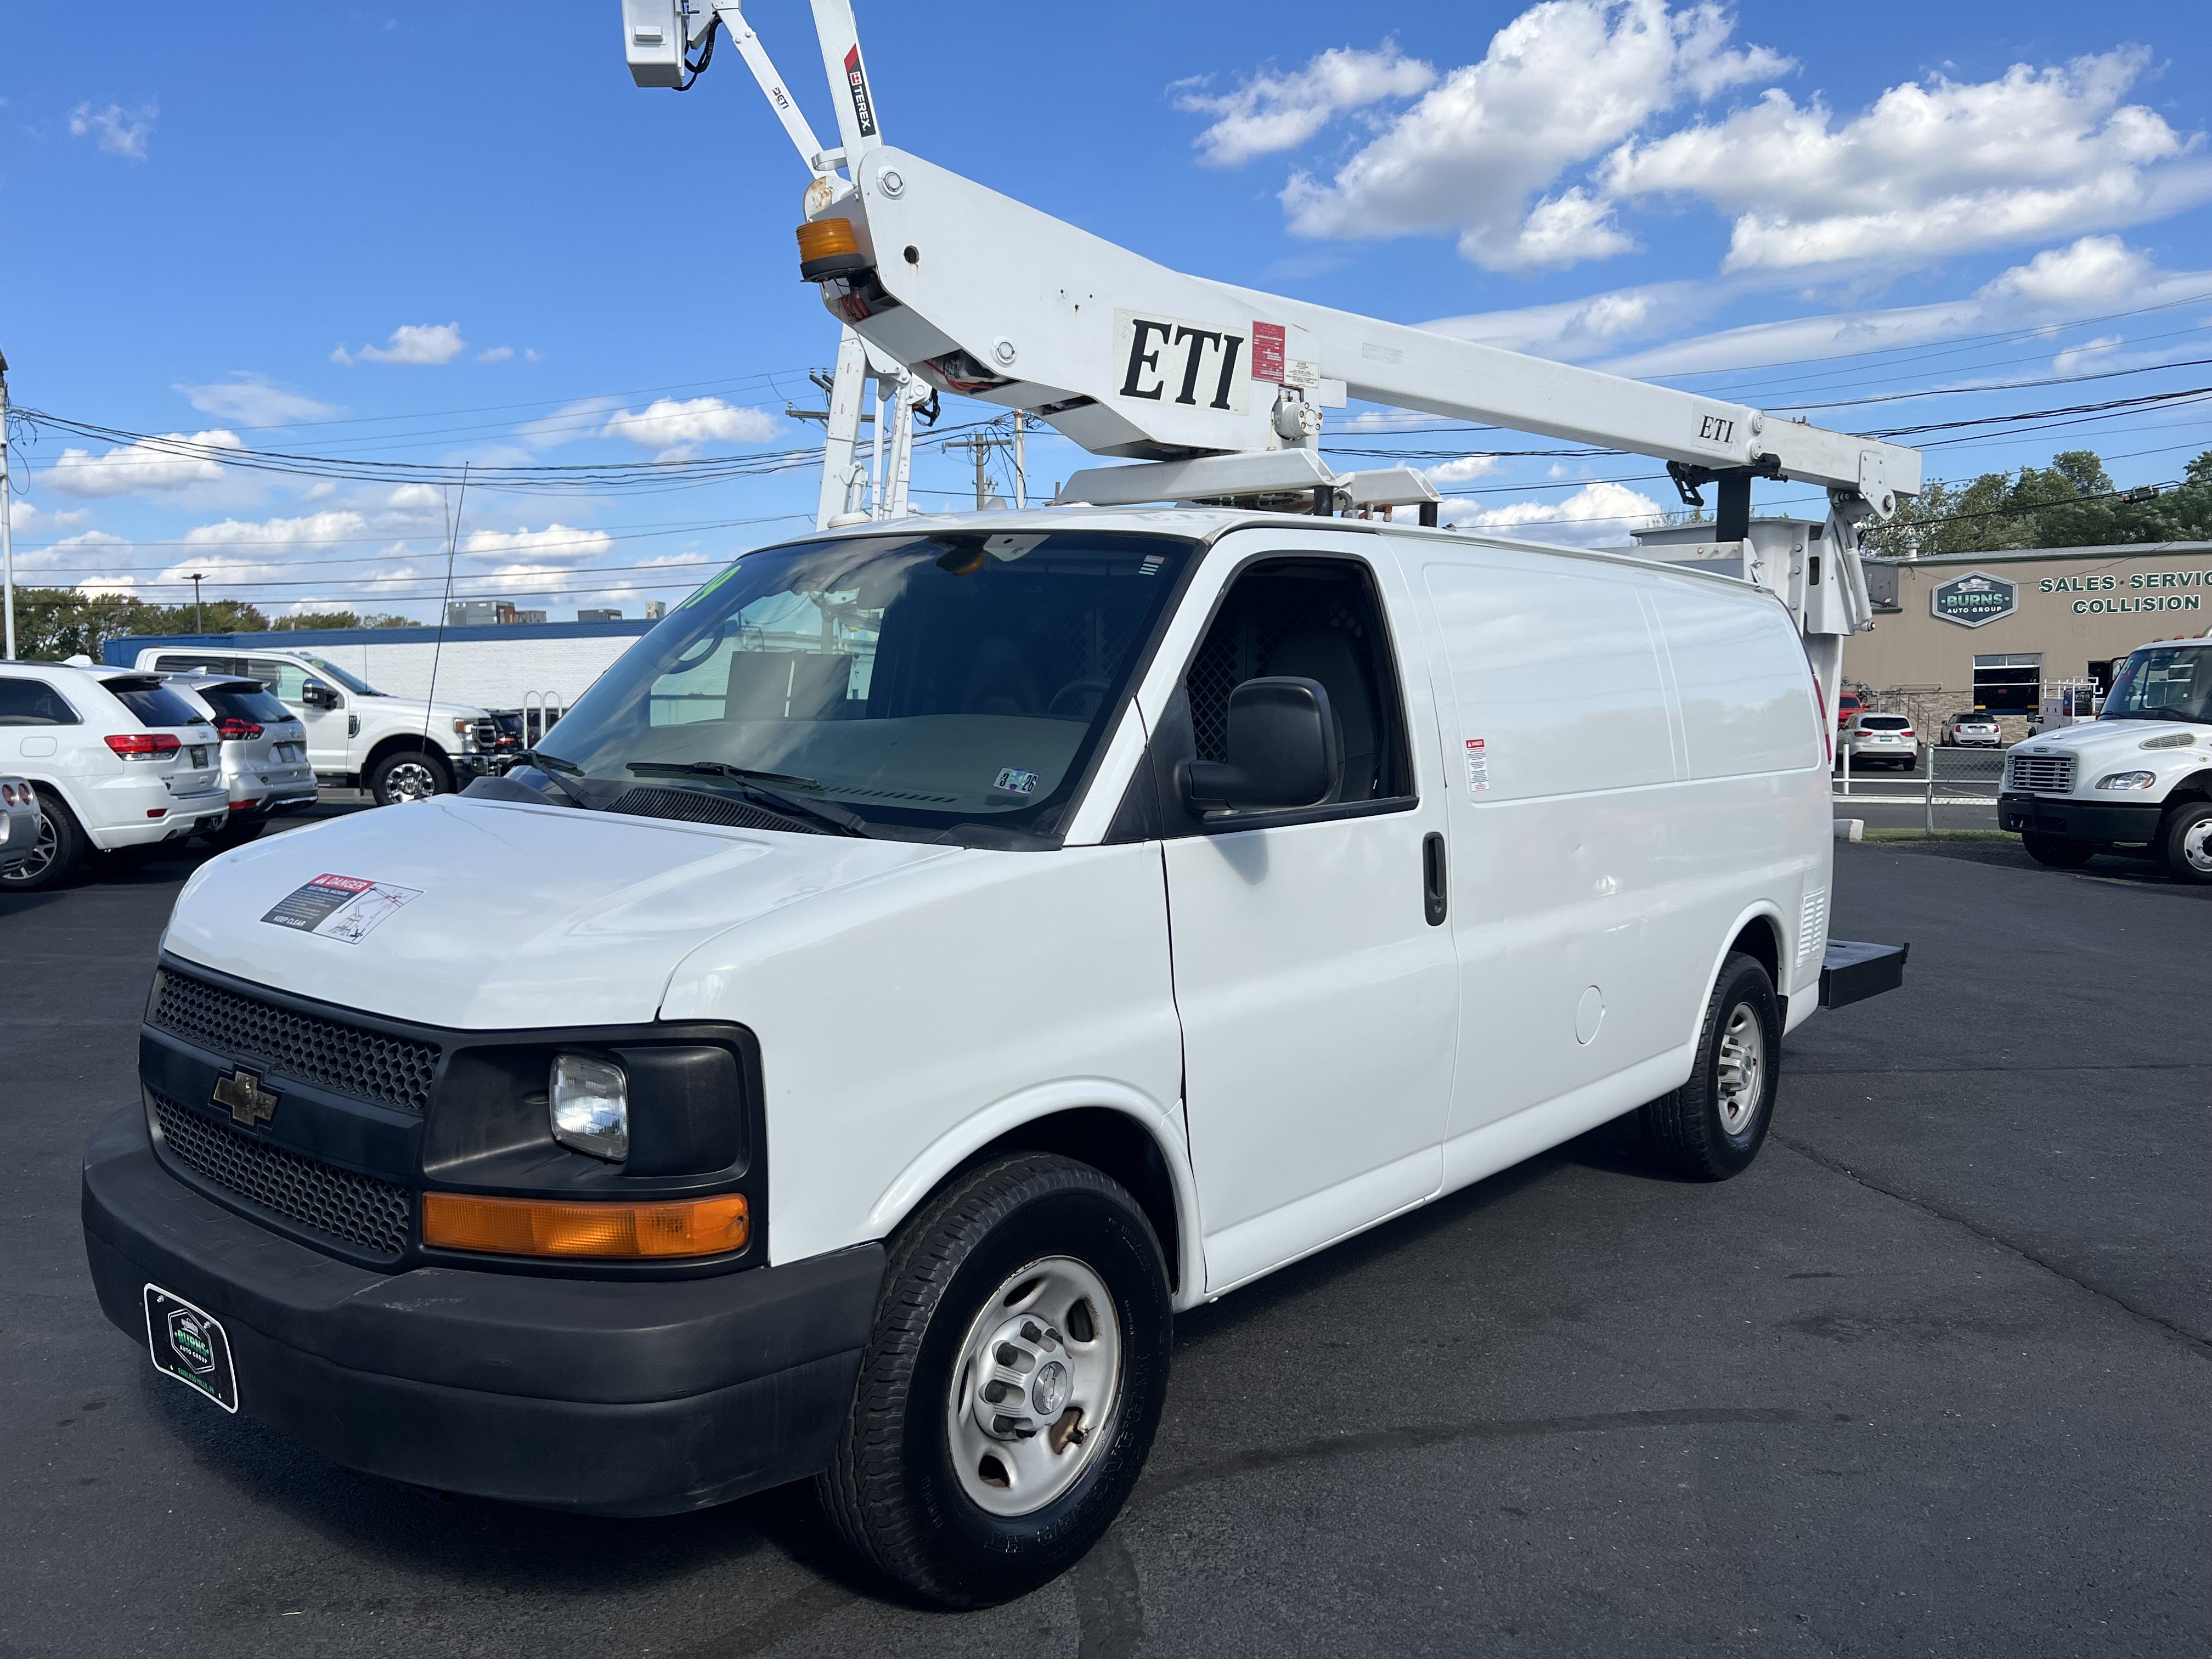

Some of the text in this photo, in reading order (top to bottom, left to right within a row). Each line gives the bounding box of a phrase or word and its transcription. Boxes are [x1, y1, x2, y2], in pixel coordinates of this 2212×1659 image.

[854, 86, 871, 129] TEREX
[1120, 319, 1244, 410] ETI
[1699, 415, 1734, 443] ETI
[2039, 575, 2116, 594] SALES
[1947, 594, 2003, 607] BURNS
[2072, 595, 2200, 615] COLLISION
[999, 772, 1037, 792] 3 26
[327, 878, 368, 890] DANGER
[273, 915, 307, 927] KEEP CLEAR
[177, 1329, 207, 1357] BURNS
[179, 1345, 208, 1364] AUTO GROUP
